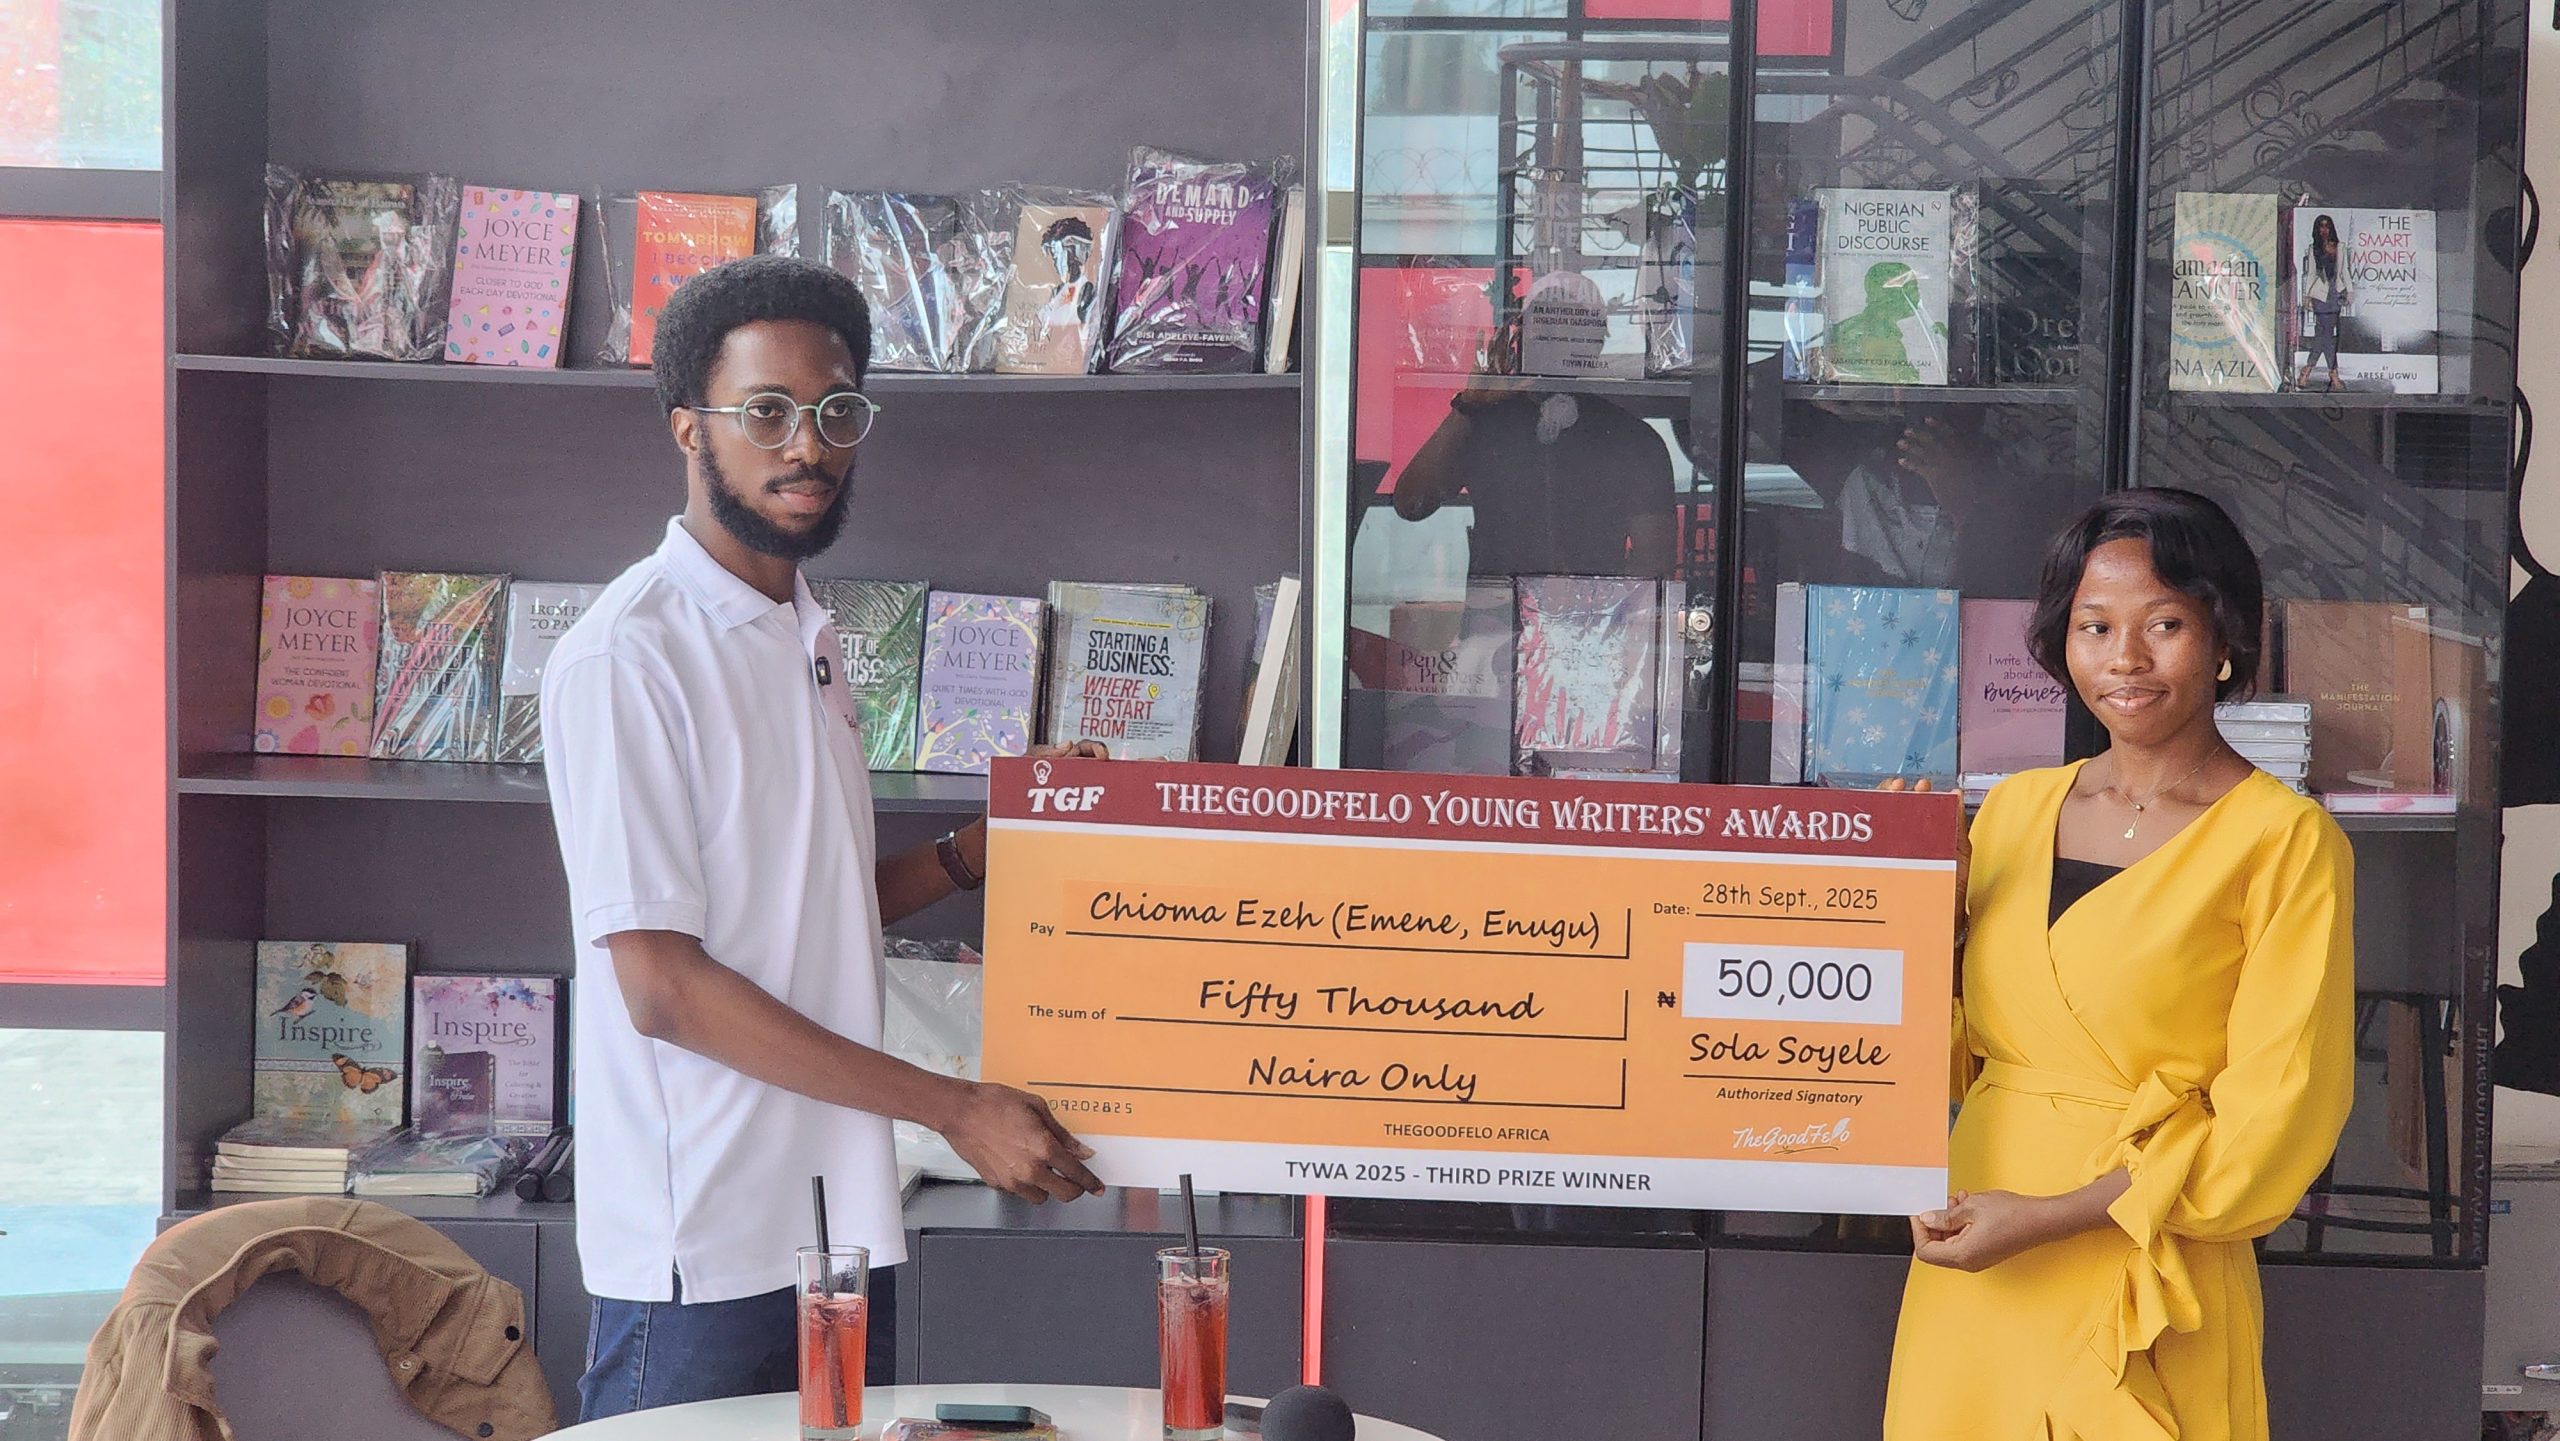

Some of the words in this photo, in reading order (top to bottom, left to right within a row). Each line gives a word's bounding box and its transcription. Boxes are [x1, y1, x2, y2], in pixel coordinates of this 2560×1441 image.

[1156, 181, 1250, 209] DEMAND
[1165, 206, 1184, 218] AND
[1187, 208, 1237, 226] SUPPLY
[1845, 202, 1924, 217] NIGERIAN
[484, 218, 553, 241] JOYCE
[1858, 219, 1911, 233] PUBLIC
[2379, 216, 2411, 230] THE
[642, 231, 750, 247] TOMORROW
[1839, 236, 1930, 251] DISCOURSE
[2358, 232, 2412, 248] SMART
[476, 242, 553, 265] MEYER
[2352, 250, 2416, 265] MONEY
[2173, 257, 2259, 280] amadan
[2348, 267, 2416, 282] WOMAN
[460, 286, 483, 295] EACH
[486, 288, 505, 297] DAY
[506, 290, 559, 302] DEVOTIONAL
[511, 279, 521, 288] TO
[524, 281, 543, 289] GOD
[1570, 319, 1607, 328] DIASPORA
[2212, 360, 2260, 378] AZIZ
[2357, 372, 2384, 380] ARESE
[2388, 372, 2418, 380] UGWU
[285, 608, 358, 629] JOYCE
[278, 633, 358, 653] MEYER
[952, 626, 1019, 647] JOYCE
[1088, 630, 1157, 653] STARTING
[1159, 636, 1169, 654] A
[944, 651, 1019, 671] MEYER
[1087, 649, 1175, 677] BUSINESS:
[1995, 653, 2021, 666] write
[272, 678, 305, 687] WOMAN
[307, 680, 361, 689] DEVOTIONAL
[2003, 669, 2033, 680] about
[932, 684, 955, 693] QUIET
[959, 686, 983, 695] TIMES
[985, 687, 1006, 696] WITH
[1009, 689, 1028, 697] GOD
[1084, 675, 1145, 699] WHERE
[2321, 692, 2401, 702] MANIFESTATION
[2351, 683, 2369, 692] THE
[954, 696, 1006, 707] DEVOTIONAL
[1083, 696, 1102, 716] TO
[1106, 699, 1155, 720] START
[2336, 703, 2385, 711] JOURNAL
[1080, 717, 1126, 739] FROM
[1027, 786, 1105, 813] TGF
[1156, 782, 1411, 824] THEGOODFELO
[1421, 790, 1540, 830] YOUNG
[1551, 795, 1712, 836] WRITERS'
[1720, 804, 1874, 842] AWARDS
[1653, 902, 1690, 916] Date:
[1702, 883, 1751, 905] 28th
[1758, 886, 1819, 912] Sept.,
[1826, 888, 1878, 910] 2025
[1030, 922, 1055, 938] Pay
[1090, 890, 1225, 925] Chioma
[1235, 899, 1324, 930] Ezeh
[1331, 901, 1468, 940] (Emene,
[1483, 909, 1600, 949] Enugu)
[1717, 958, 1873, 1006] 50,000
[1028, 1005, 1053, 1019] The
[1057, 1009, 1086, 1020] sum
[1092, 1007, 1106, 1020] of
[1199, 980, 1298, 1019] Fifty
[1316, 986, 1544, 1021] Thousand
[280, 1016, 377, 1050] Inspire
[432, 1011, 531, 1046] Inspire
[1690, 1032, 1770, 1063] Sola
[1778, 1037, 1891, 1073] Soyele
[429, 1074, 471, 1089] Inspire
[1248, 1056, 1370, 1087] Naira
[1380, 1063, 1478, 1101] Only
[1717, 1087, 1793, 1103] Authorized
[1796, 1089, 1863, 1107] Signatory
[1384, 1123, 1493, 1140] THEGOODFELO
[1497, 1127, 1550, 1142] AFRICA
[1285, 1160, 1349, 1181] TYWA
[1355, 1163, 1406, 1182] 2025
[1426, 1166, 1490, 1185] THIRD
[1498, 1169, 1556, 1188] PRIZE
[1563, 1171, 1652, 1191] WINNER
